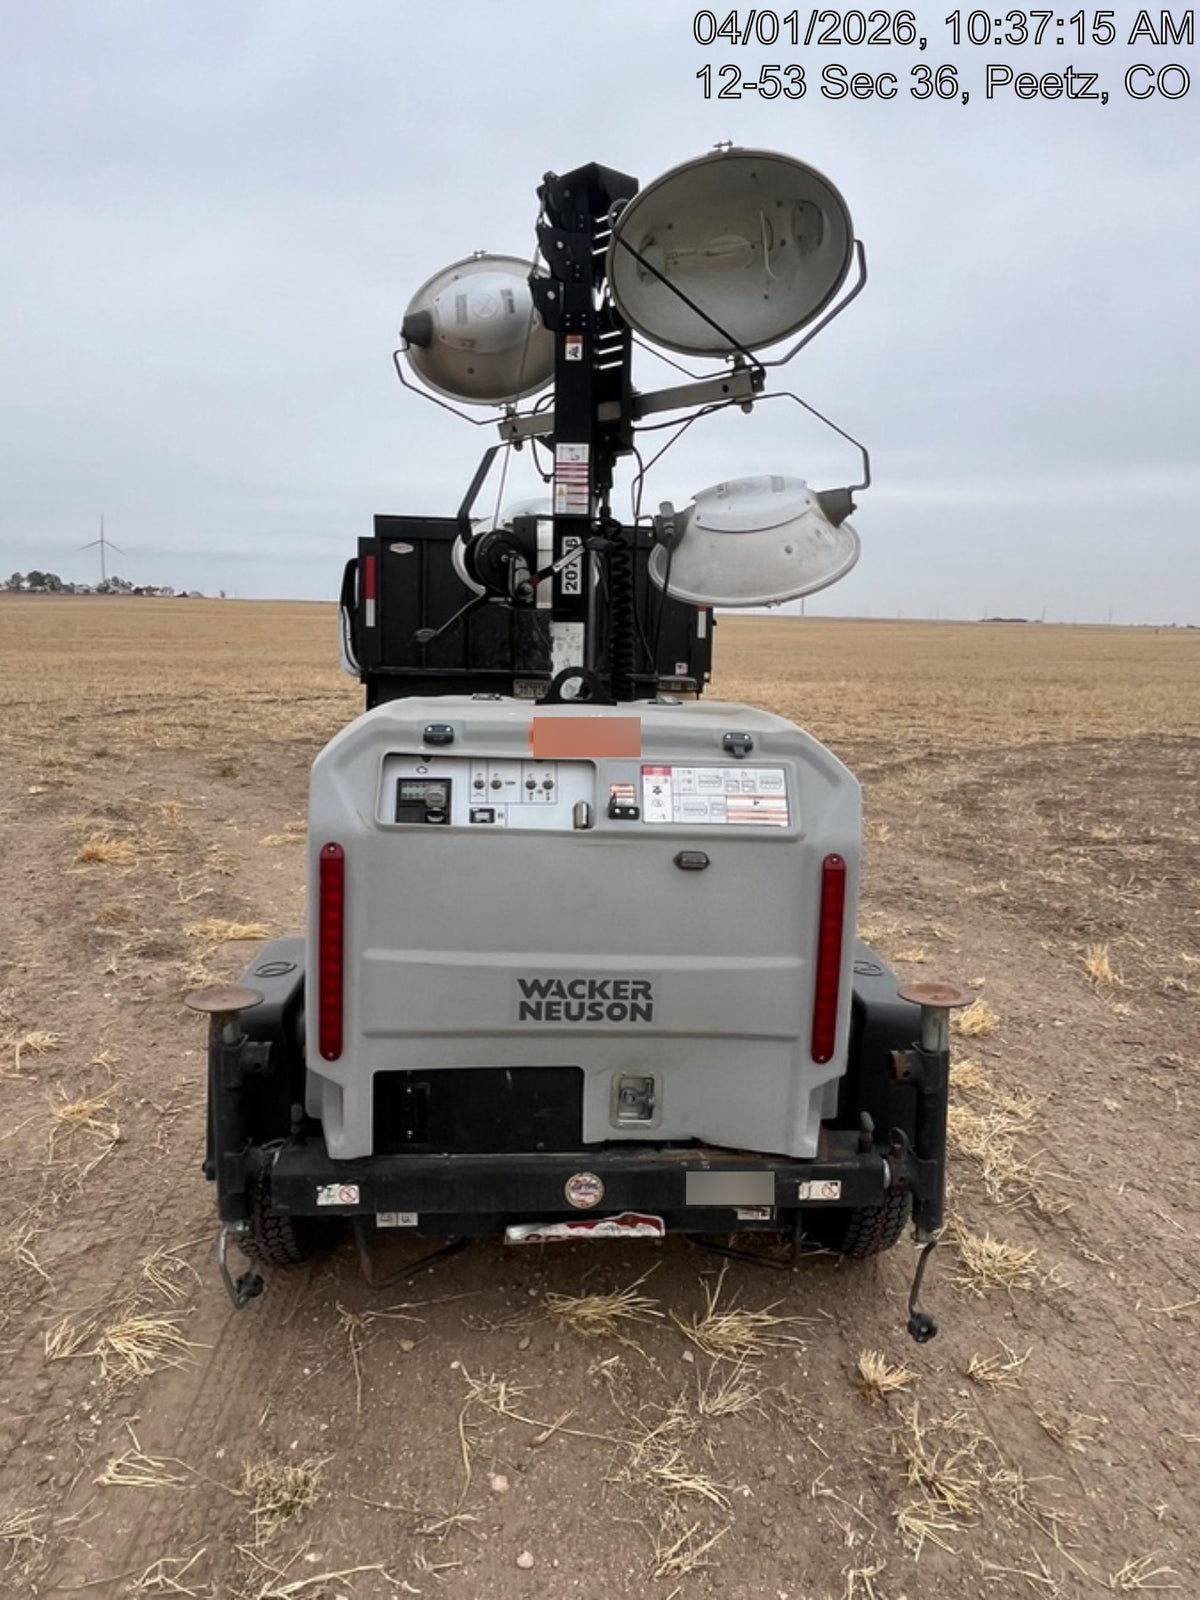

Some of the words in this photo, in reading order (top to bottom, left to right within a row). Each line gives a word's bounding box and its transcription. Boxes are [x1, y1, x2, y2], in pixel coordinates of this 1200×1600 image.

[564, 537, 579, 592] 2076
[517, 978, 654, 1001] WACKER
[518, 1000, 654, 1023] NEUSON
